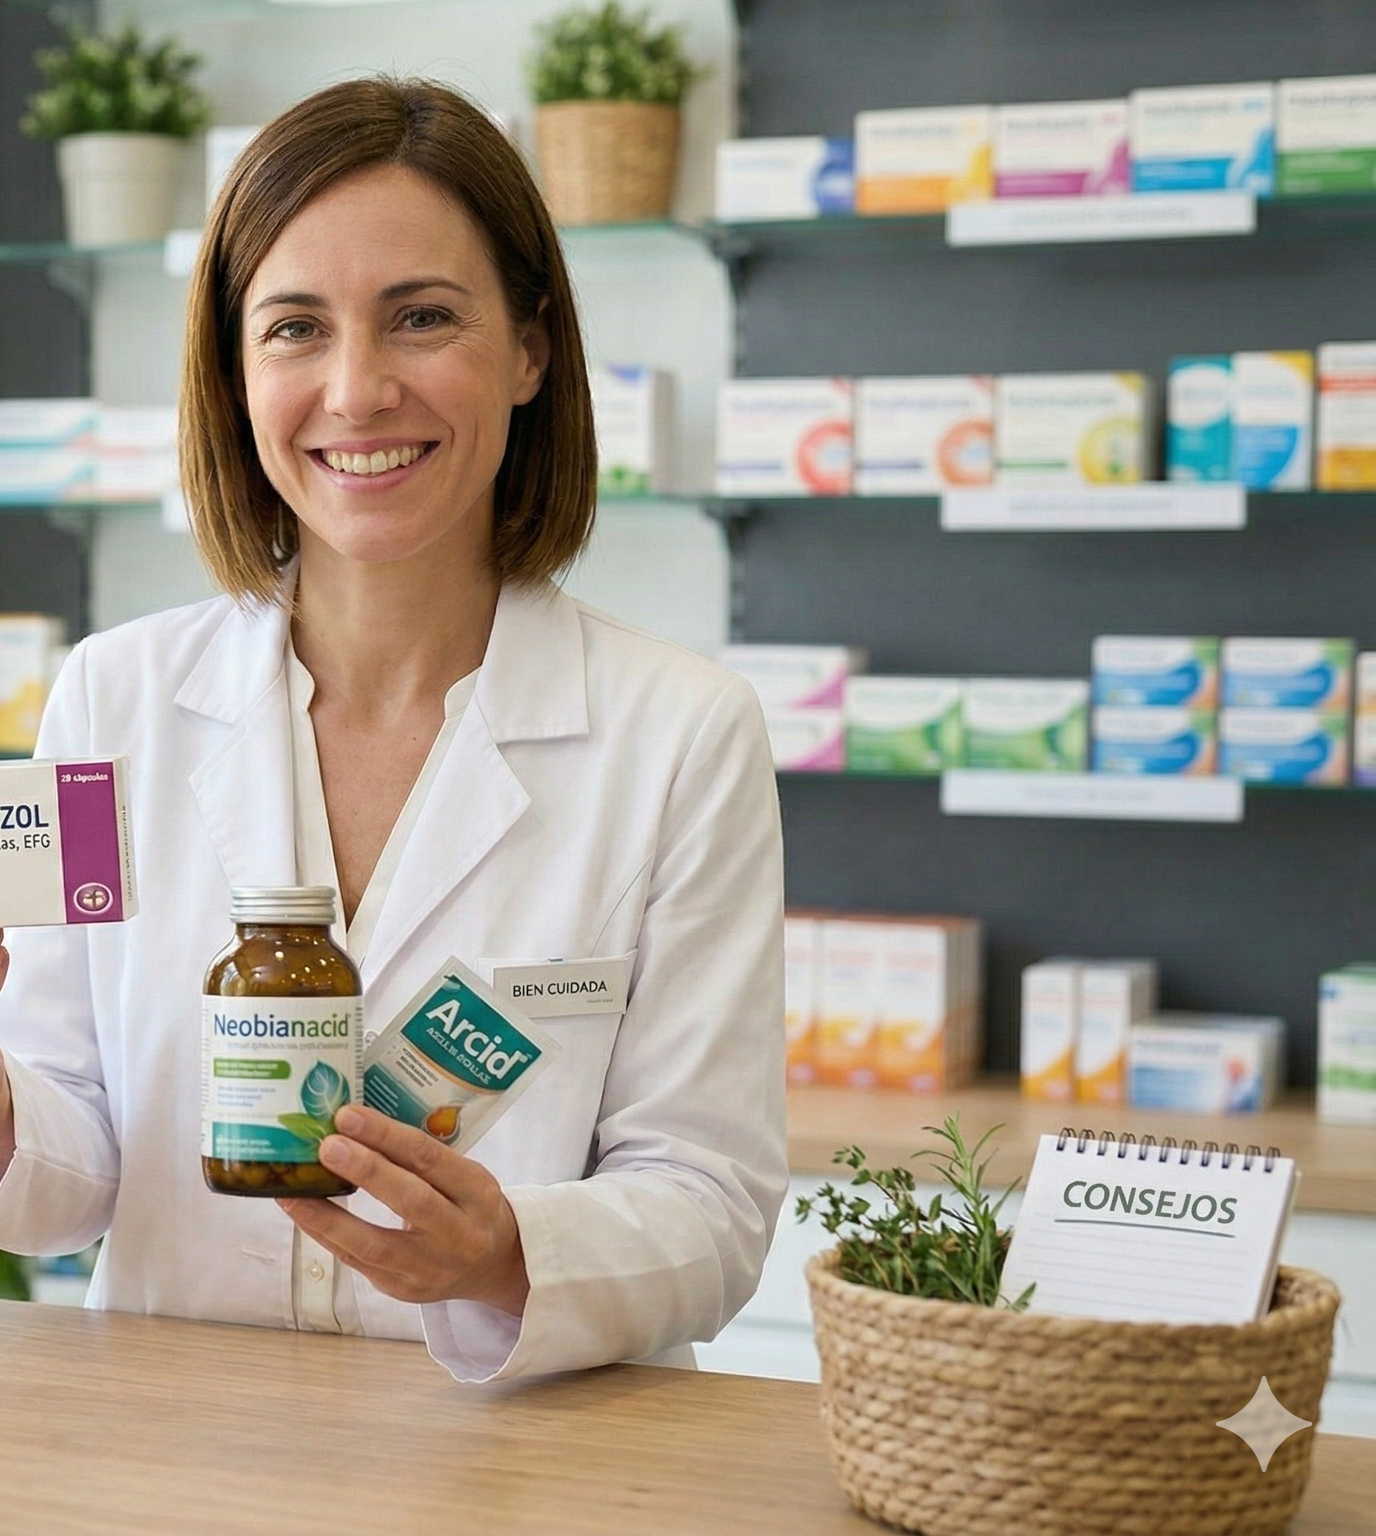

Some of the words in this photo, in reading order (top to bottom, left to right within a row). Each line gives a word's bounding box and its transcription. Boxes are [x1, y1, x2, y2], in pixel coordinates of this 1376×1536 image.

[23, 833, 51, 849] EFG
[513, 984, 544, 997] BIEN
[547, 980, 608, 995] CUIDADA
[1063, 1180, 1238, 1225] CONSEJOS
